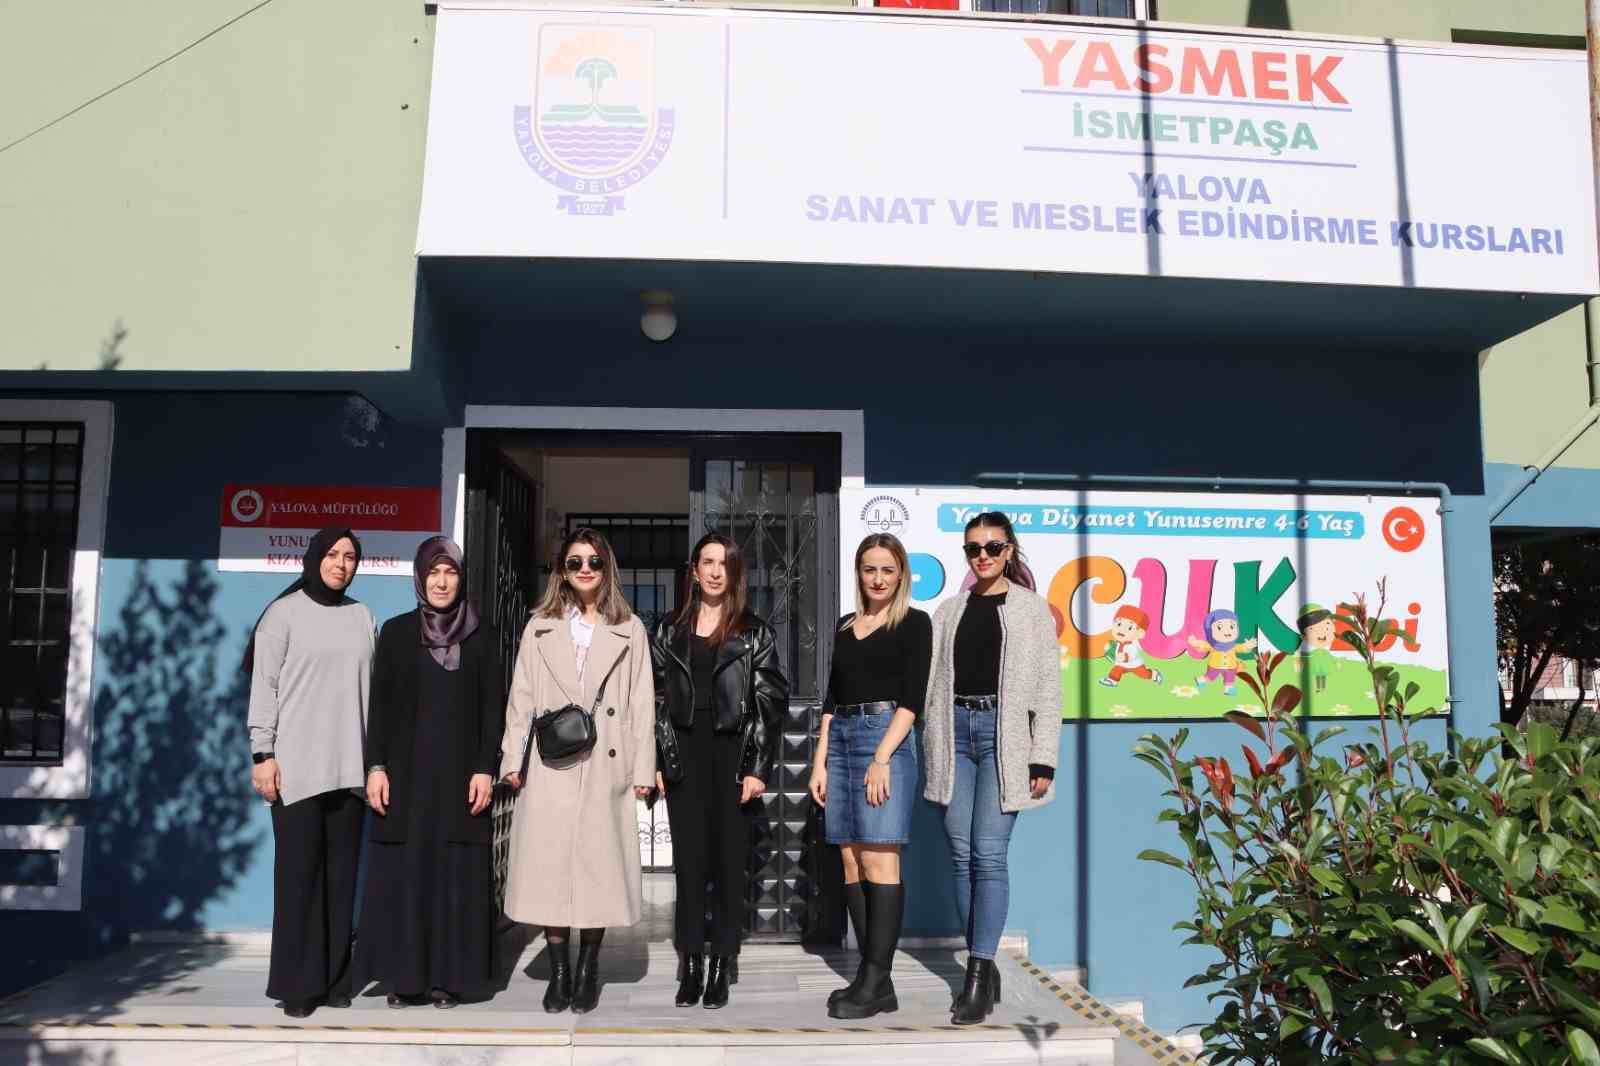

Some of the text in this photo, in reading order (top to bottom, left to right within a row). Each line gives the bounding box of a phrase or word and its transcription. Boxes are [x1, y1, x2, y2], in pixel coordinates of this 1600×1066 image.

[1024, 38, 1349, 104] YASMEK
[1072, 102, 1319, 155] İSMETPAŞA
[514, 118, 561, 184] YALOVA
[1128, 171, 1272, 204] YALOVA
[805, 194, 1564, 255] SANAT VE MESLEK EDİNDİRME KURSLARI
[271, 502, 400, 516] YALOVA MÜFTÜLÜĞÜ
[951, 505, 1354, 537] Yava Diyanet Yunusemre 4-6 Yaş
[268, 535, 309, 547] YUNU
[266, 553, 291, 565] KIZ
[361, 555, 400, 569] URSU
